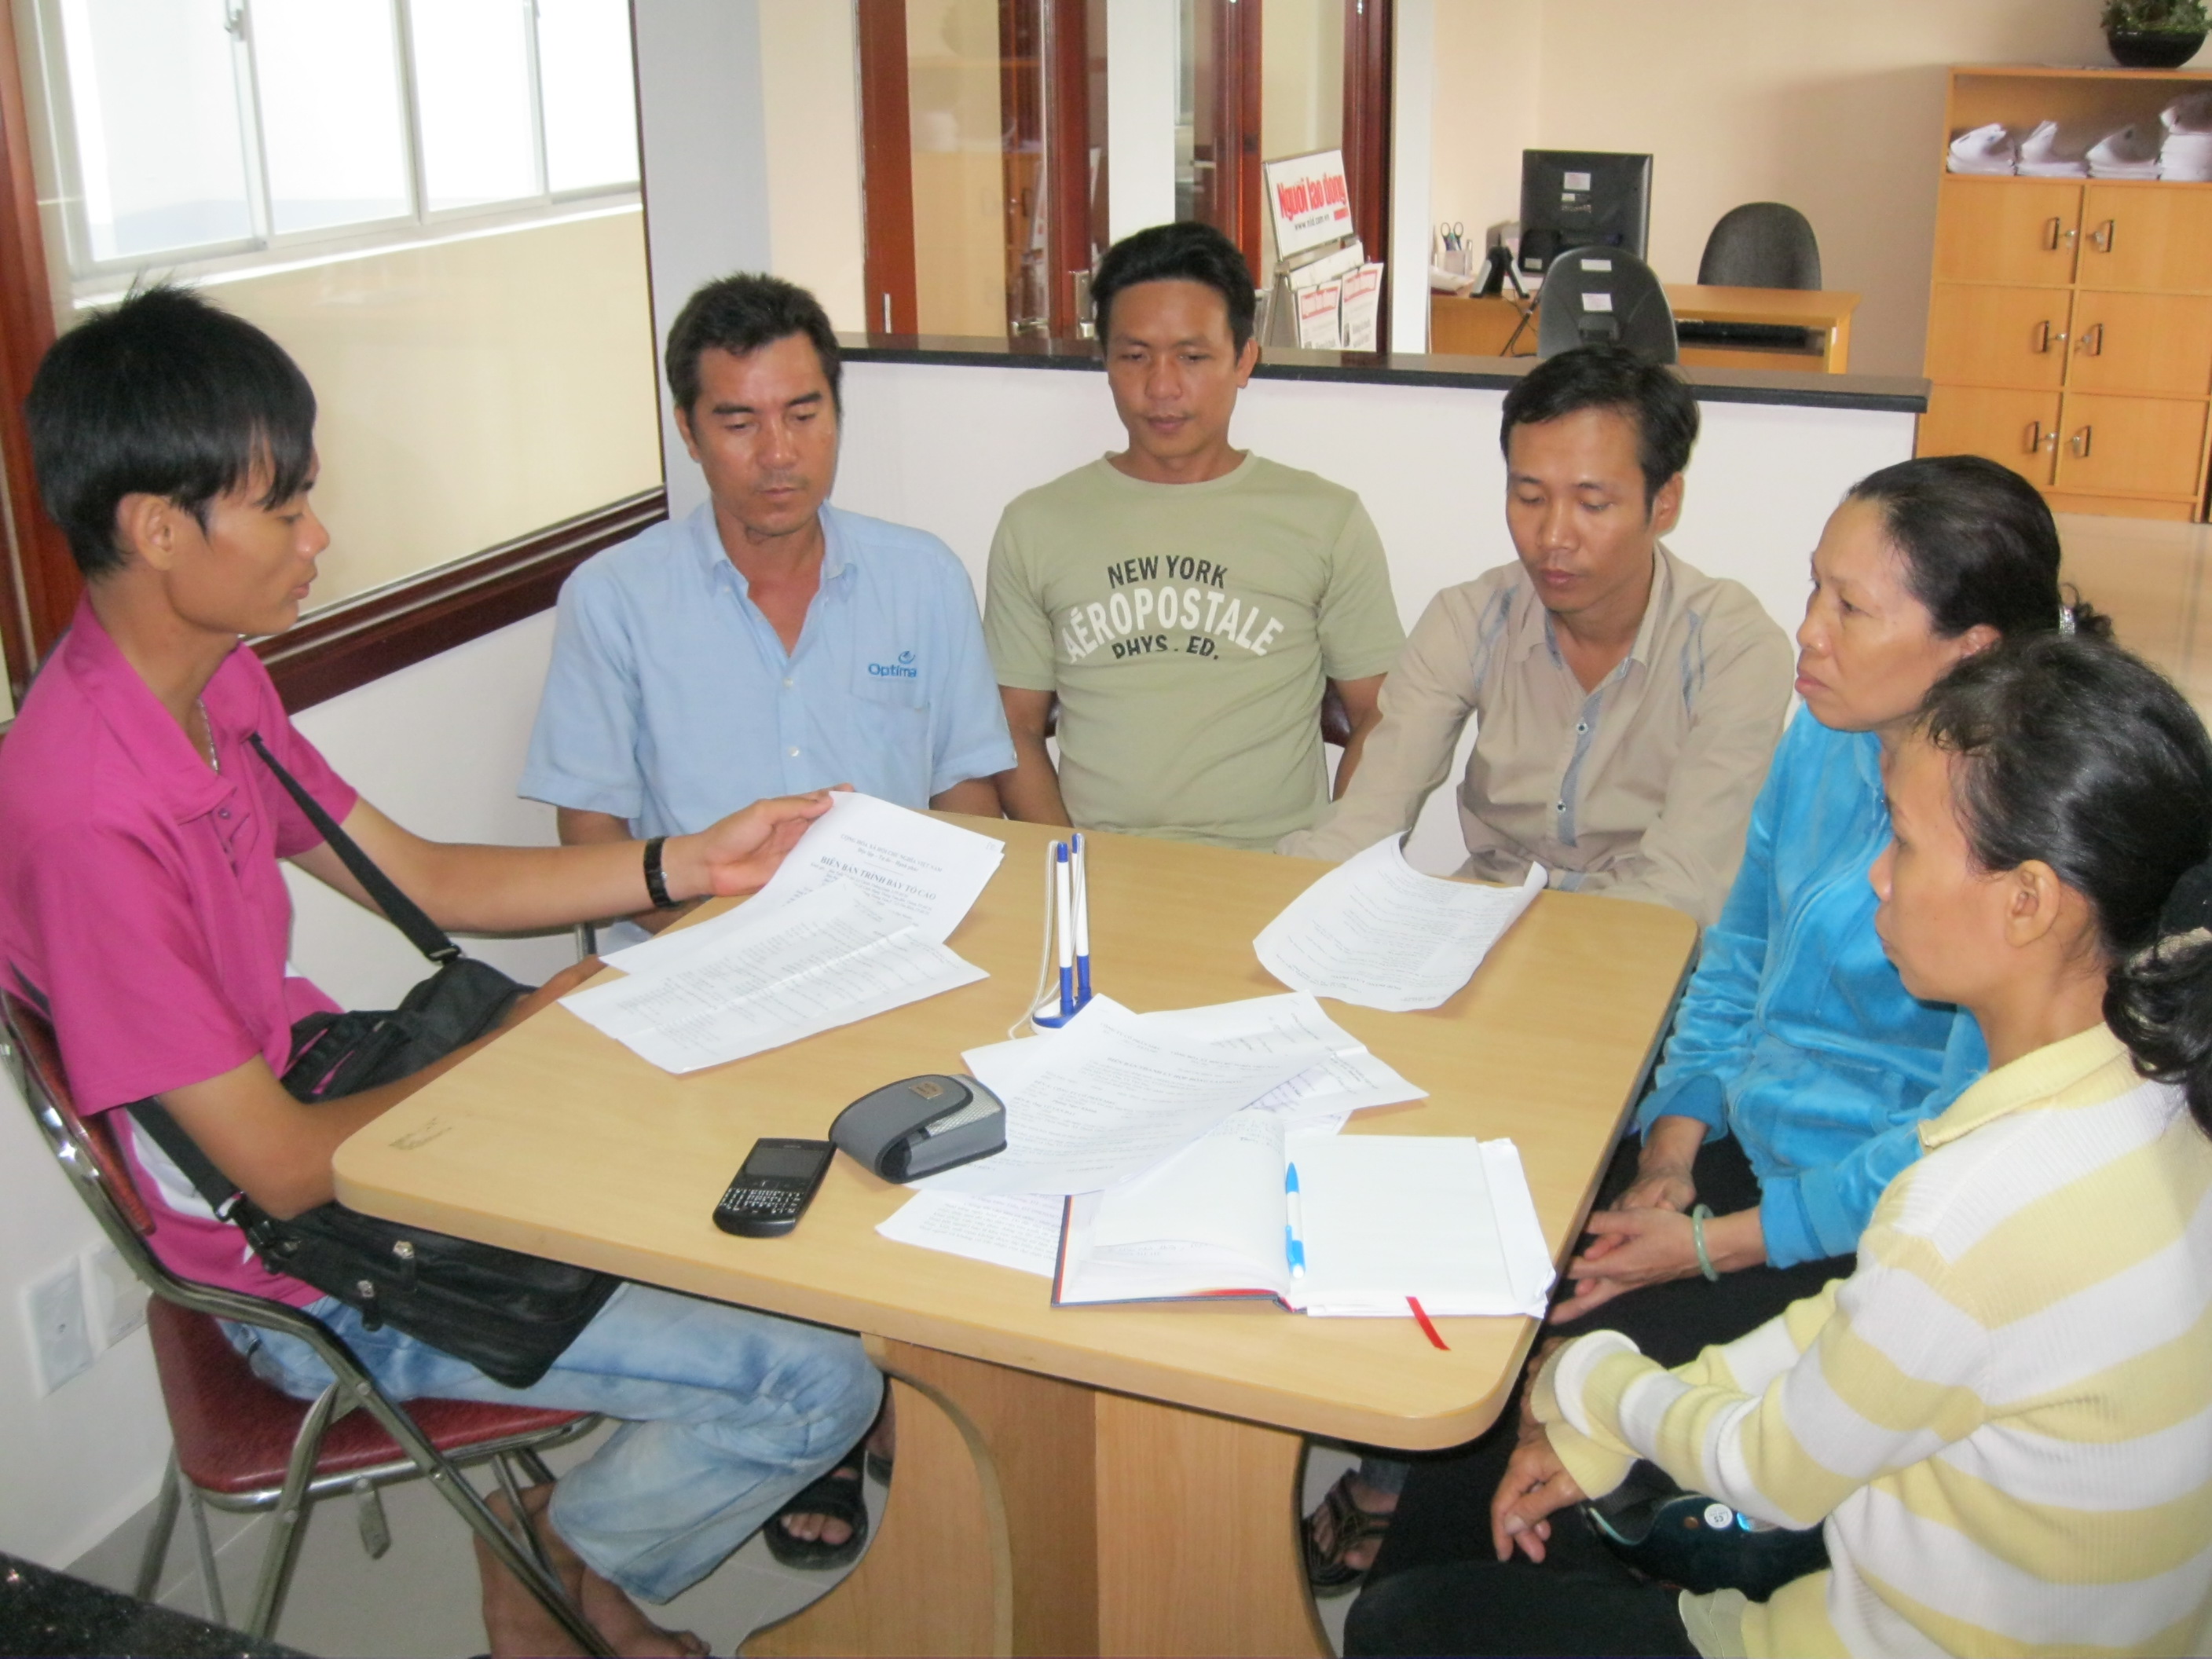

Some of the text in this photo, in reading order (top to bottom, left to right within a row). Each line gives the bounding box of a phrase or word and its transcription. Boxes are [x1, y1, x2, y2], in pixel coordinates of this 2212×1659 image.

[1108, 555, 1228, 589] NEW YORK
[1062, 586, 1284, 664] AÉROPOSTALE
[1185, 635, 1219, 661] ED.
[868, 664, 917, 678] Optima
